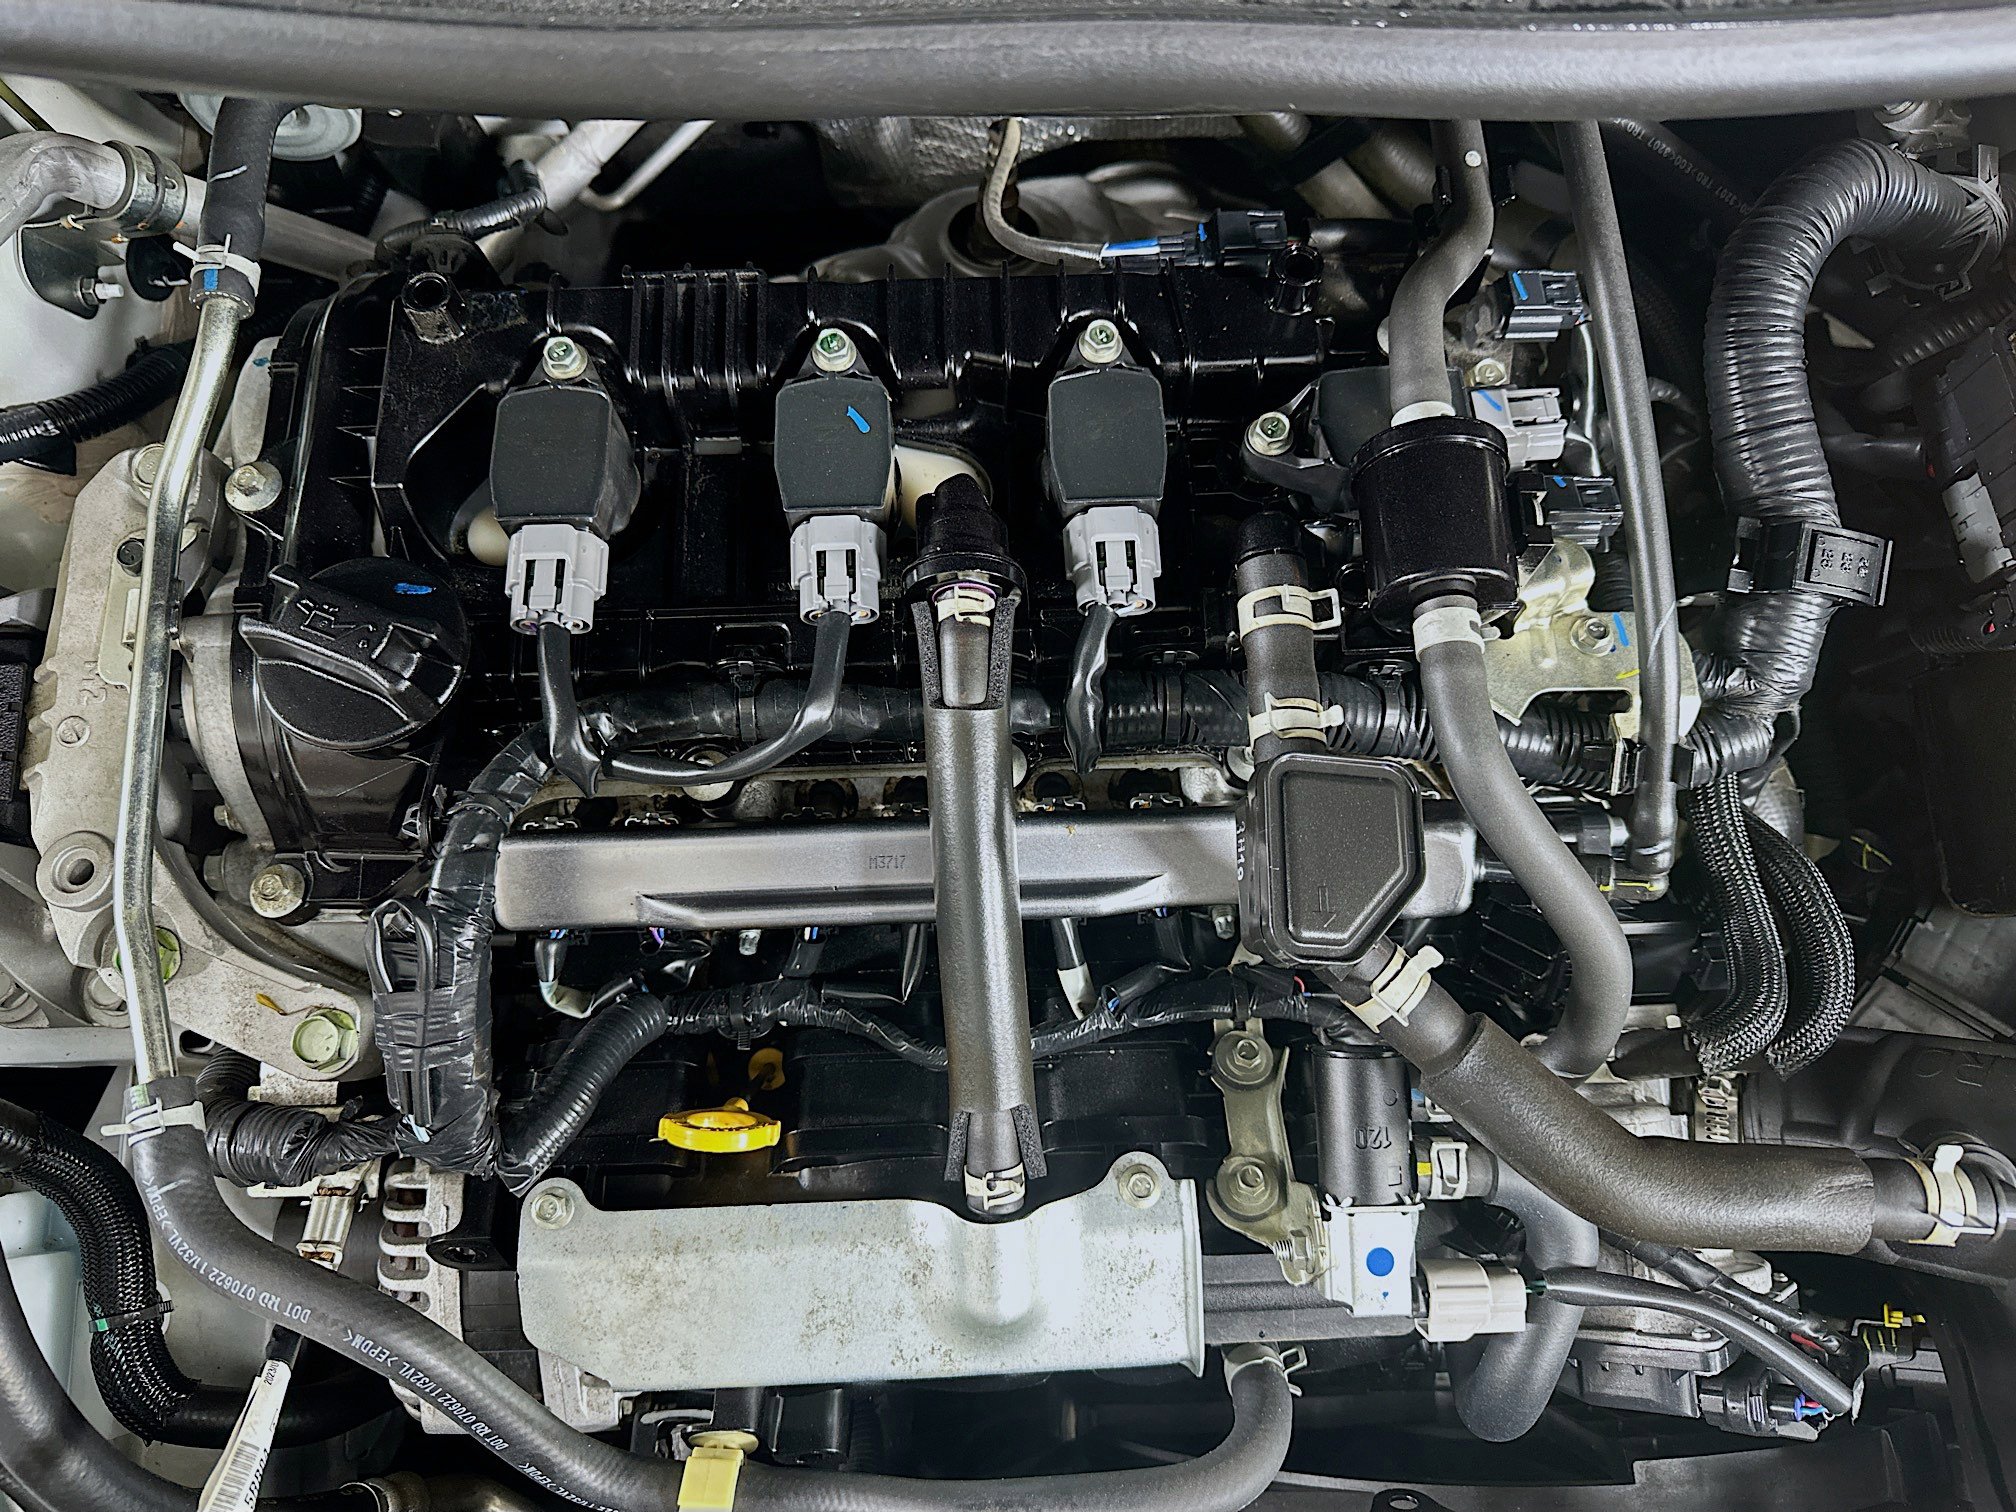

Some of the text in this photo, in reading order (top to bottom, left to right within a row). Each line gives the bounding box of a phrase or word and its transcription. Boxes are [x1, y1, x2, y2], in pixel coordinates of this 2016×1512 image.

[869, 855, 906, 870] M3717
[1354, 1126, 1392, 1150] 120
[208, 1267, 256, 1302] 070622
[283, 1302, 311, 1324] DOT
[342, 1329, 399, 1367] >EPDM<
[437, 1393, 477, 1424] 070622
[485, 1433, 509, 1451] DOT
